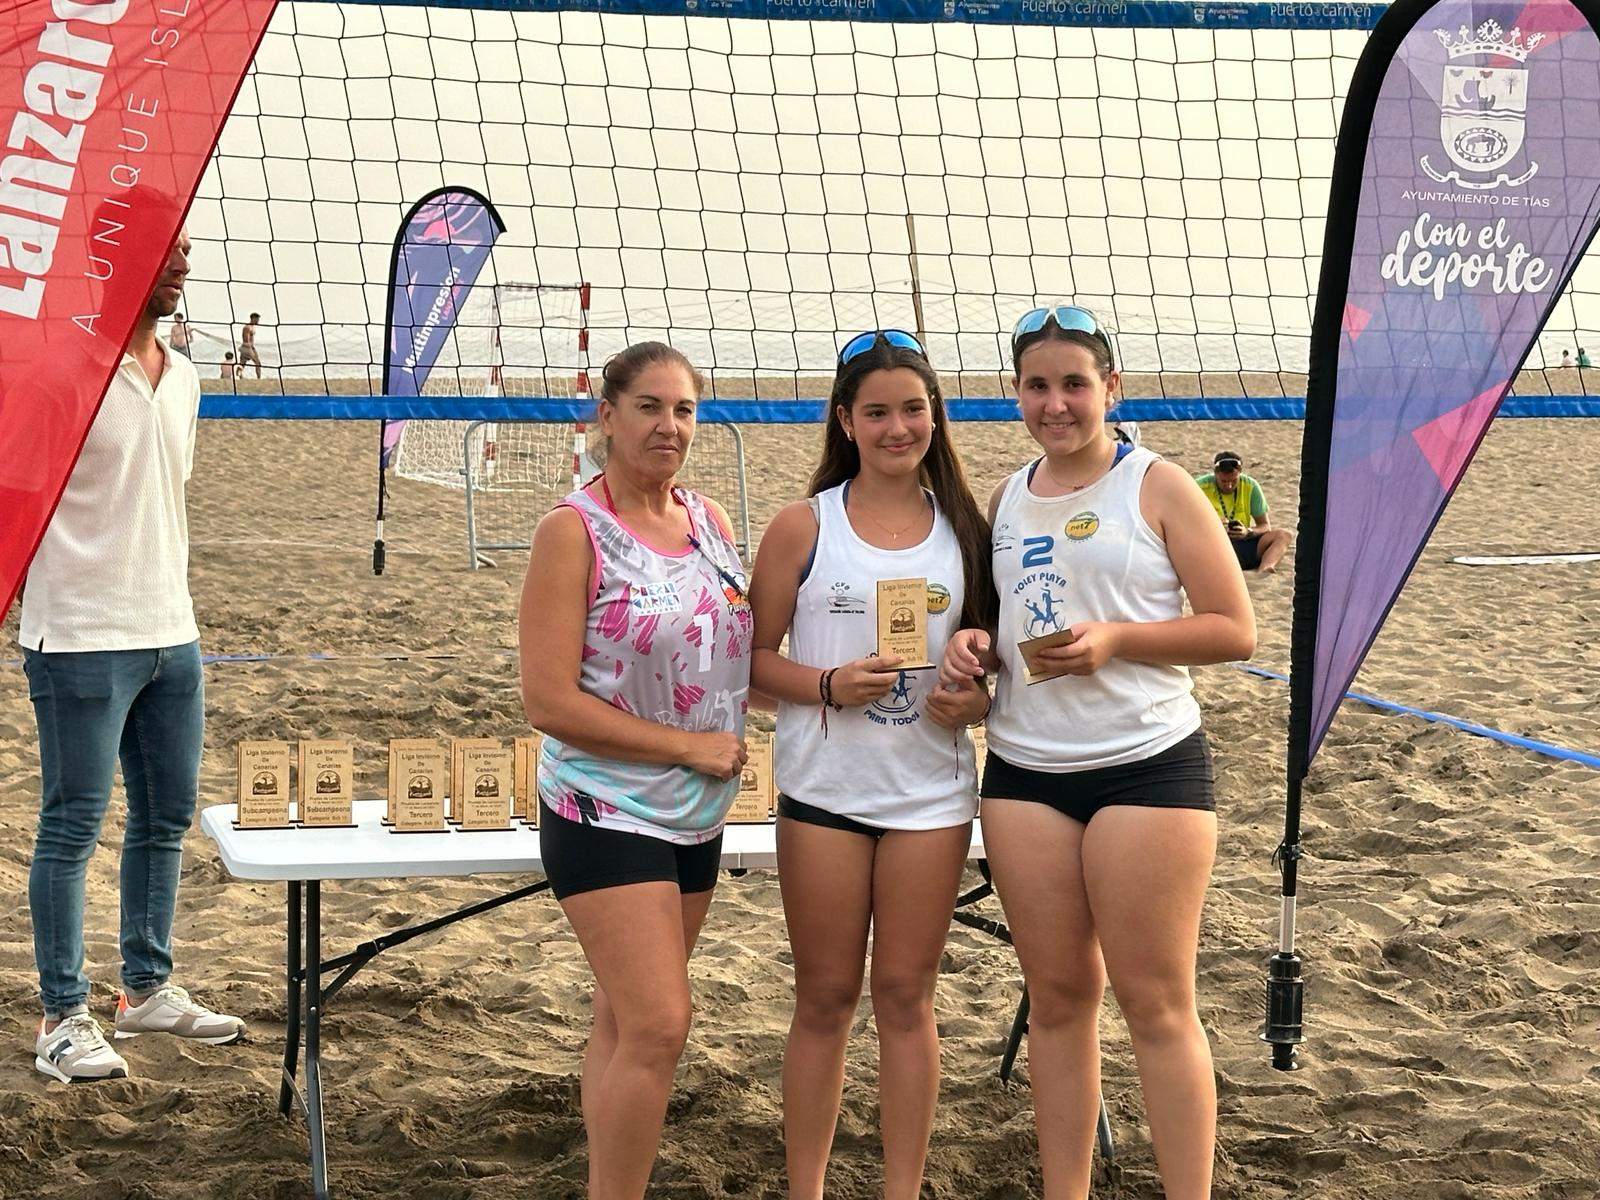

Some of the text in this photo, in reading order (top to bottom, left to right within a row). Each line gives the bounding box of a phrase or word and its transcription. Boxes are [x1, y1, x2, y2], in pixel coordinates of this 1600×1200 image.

[84, 93, 159, 281] UNIQUE
[1401, 190, 1550, 208] AYUNTAMIENTO DE TÍAS
[1414, 212, 1510, 249] Con el
[1381, 230, 1553, 300] deporte
[72, 313, 101, 336] A
[1022, 535, 1055, 568] 2
[1014, 572, 1067, 594] VOLEY PLAYA
[694, 614, 716, 672] 1
[864, 709, 920, 726] PARA TODOS
